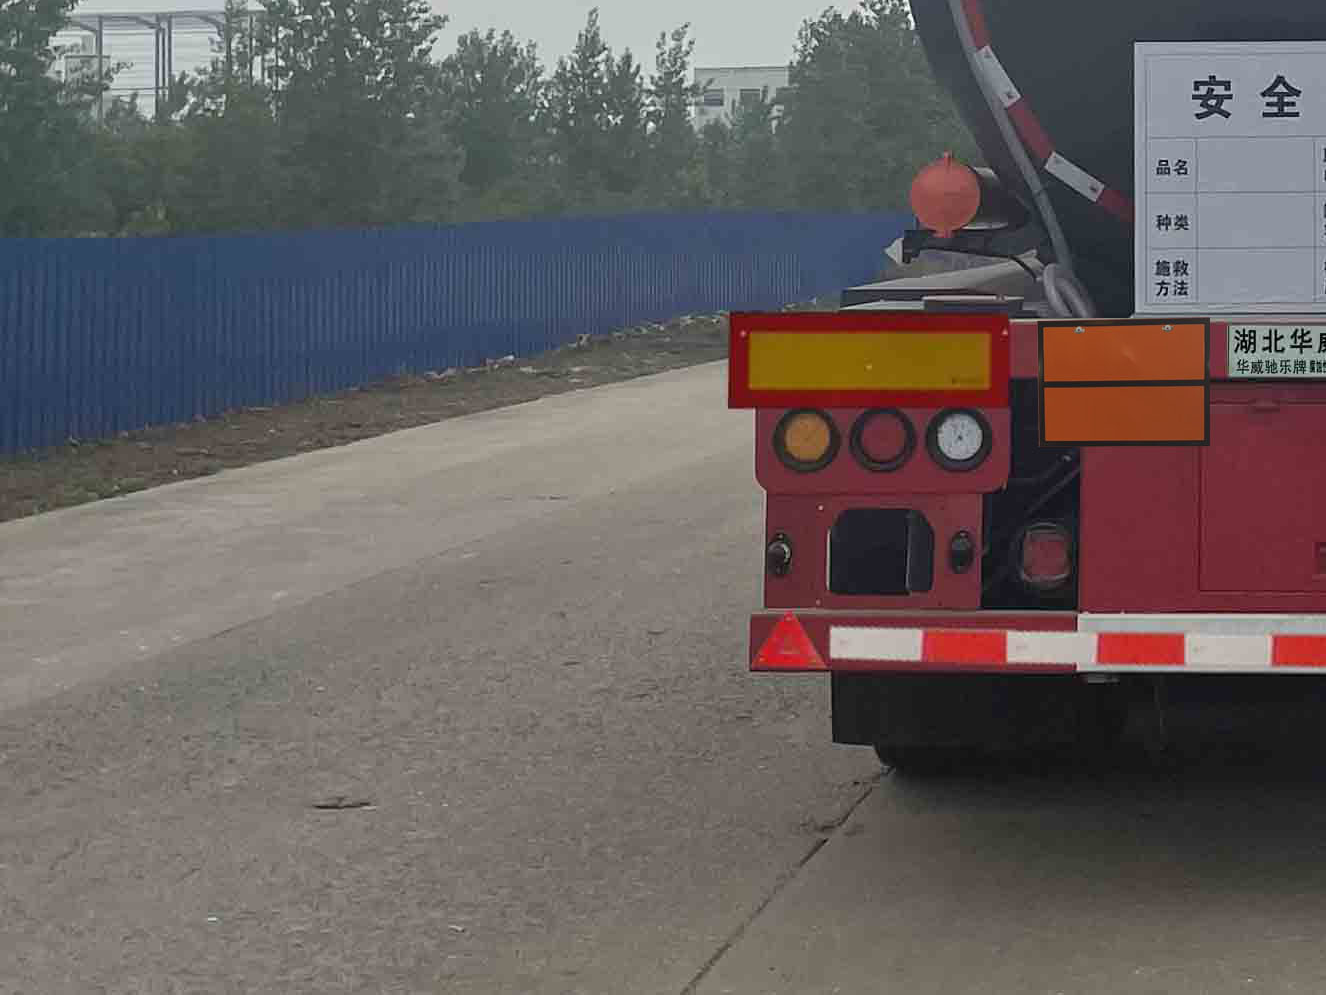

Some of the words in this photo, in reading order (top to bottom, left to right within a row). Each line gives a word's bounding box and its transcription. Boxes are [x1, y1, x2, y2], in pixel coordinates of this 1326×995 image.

[1155, 159, 1190, 177] 品名
[1155, 213, 1190, 231] 种类
[1155, 260, 1190, 277] 施救
[1155, 279, 1190, 297] 方法
[1236, 358, 1307, 375] 华威驰乐牌
